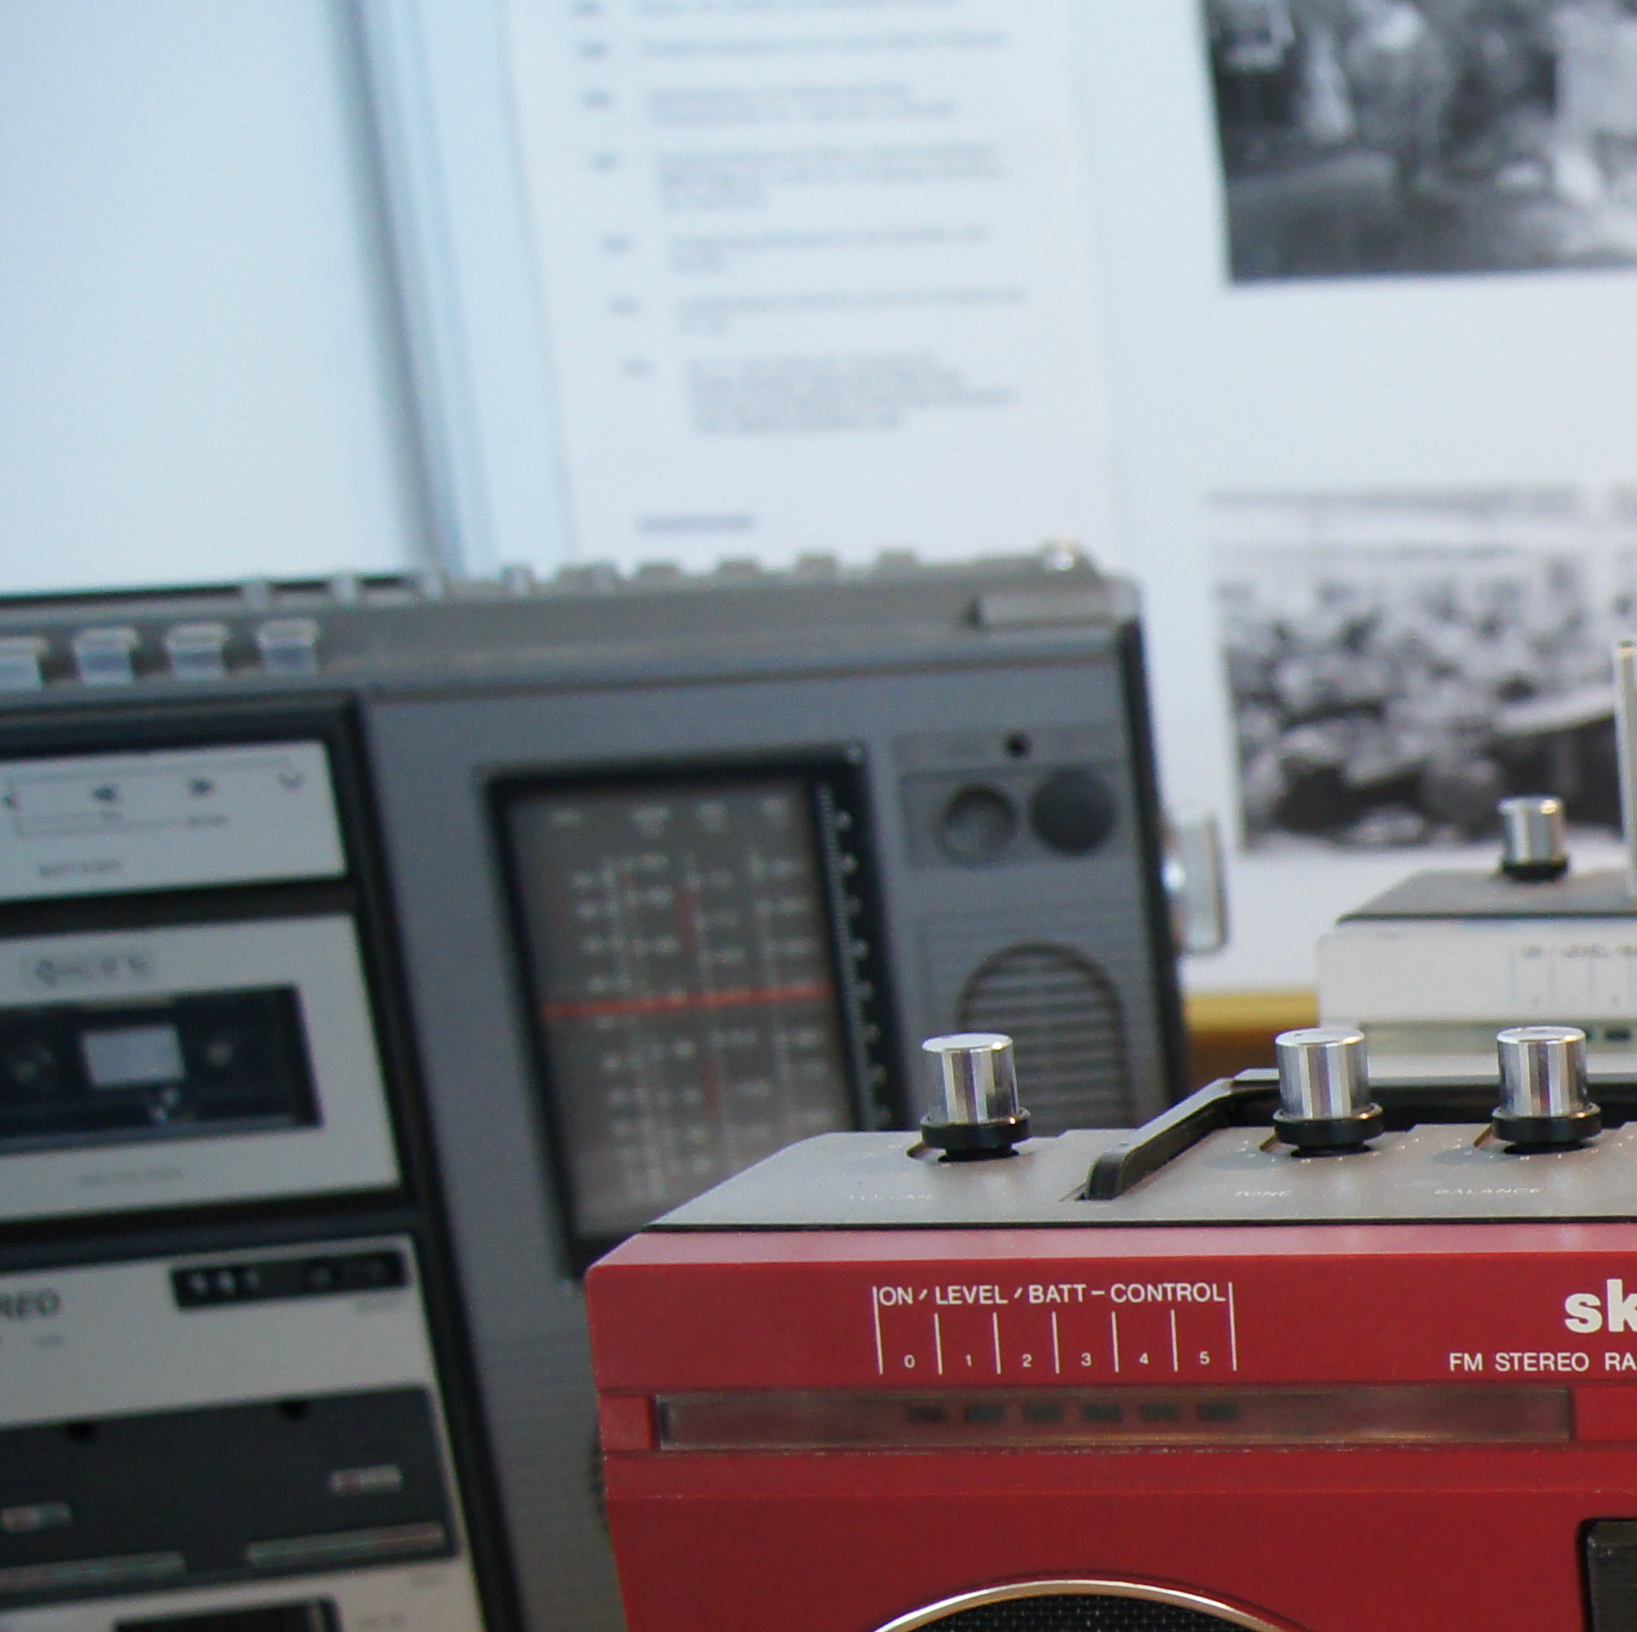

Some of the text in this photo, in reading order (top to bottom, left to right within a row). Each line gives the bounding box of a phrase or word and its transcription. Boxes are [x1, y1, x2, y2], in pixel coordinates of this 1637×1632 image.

[878, 1285, 914, 1307] ON
[935, 1284, 1009, 1305] LEVEL
[903, 1350, 1211, 1369] 0 1 2 3 4 5
[1449, 1352, 1483, 1372] FM
[1494, 1351, 1590, 1372] STEREO
